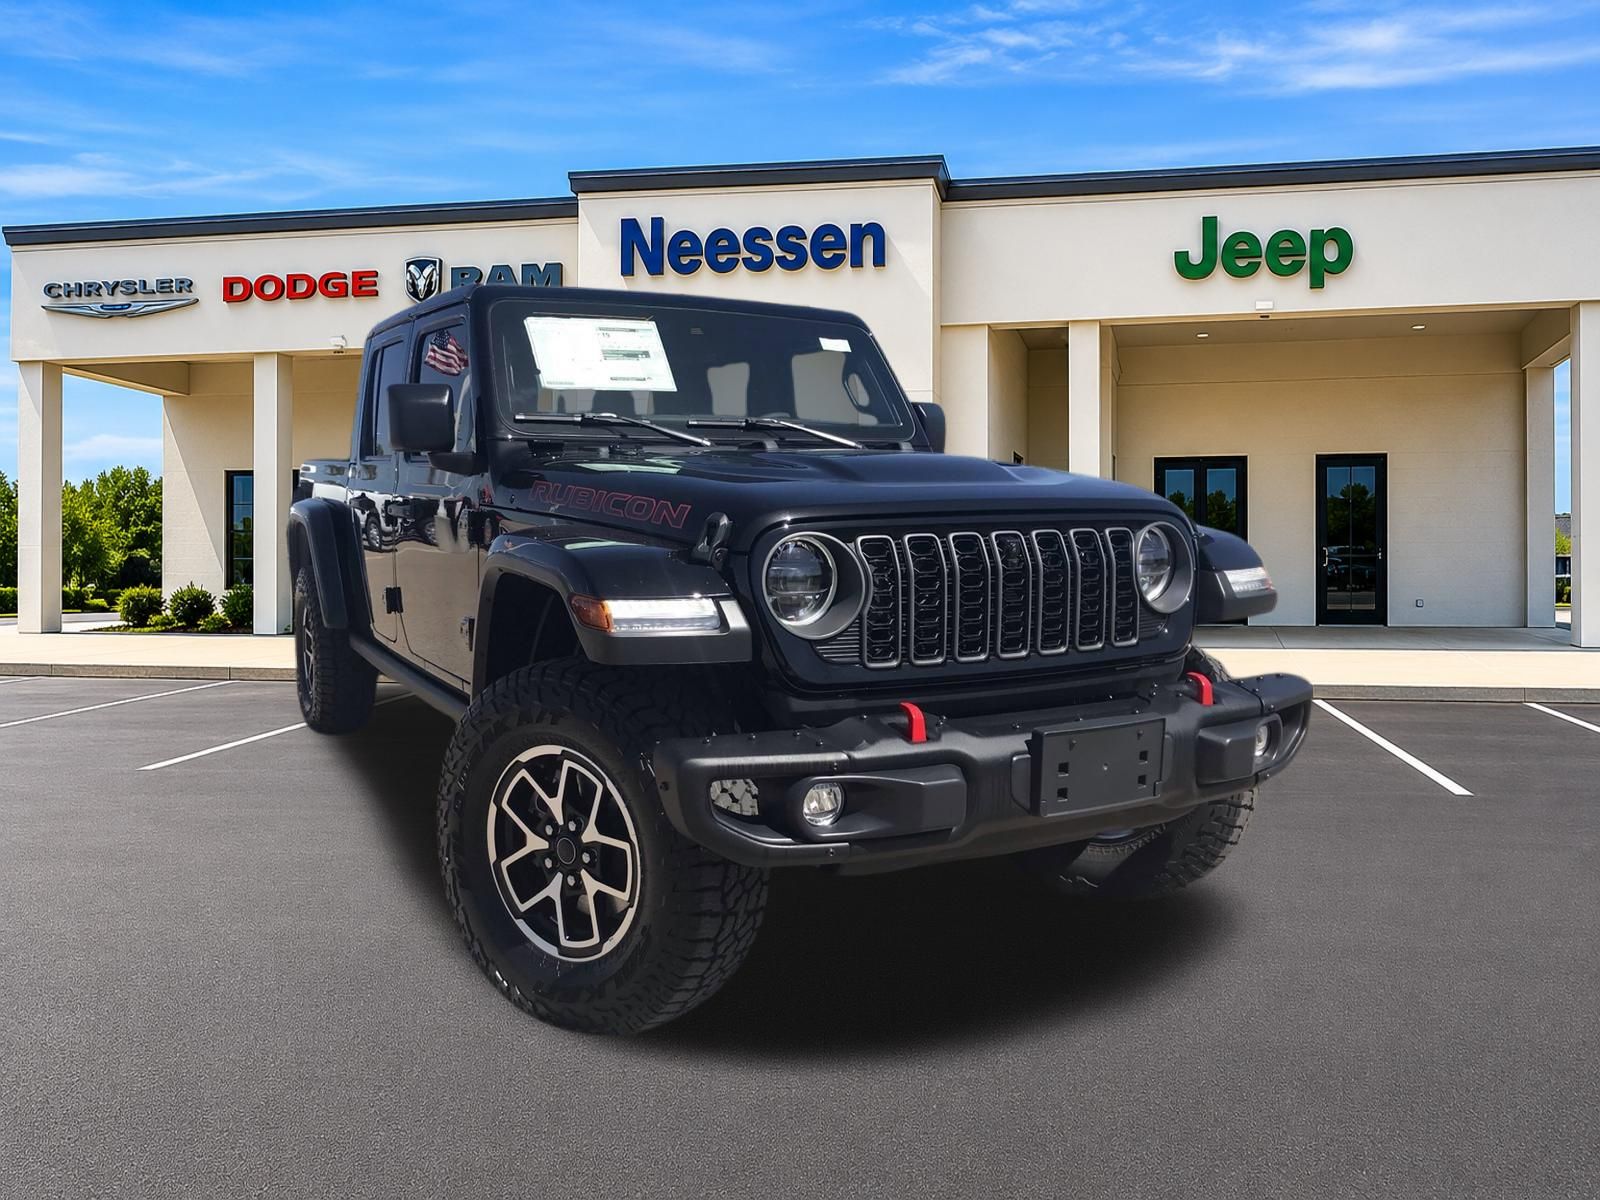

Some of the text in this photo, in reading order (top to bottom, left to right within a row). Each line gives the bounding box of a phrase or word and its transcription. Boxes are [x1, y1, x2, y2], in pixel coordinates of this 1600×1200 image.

[620, 216, 886, 277] Neessen
[1174, 215, 1354, 289] Jeep
[43, 278, 194, 298] CHRYSLER
[222, 270, 379, 303] DODGE
[450, 262, 563, 290] RAM
[529, 480, 692, 529] RUBICON
